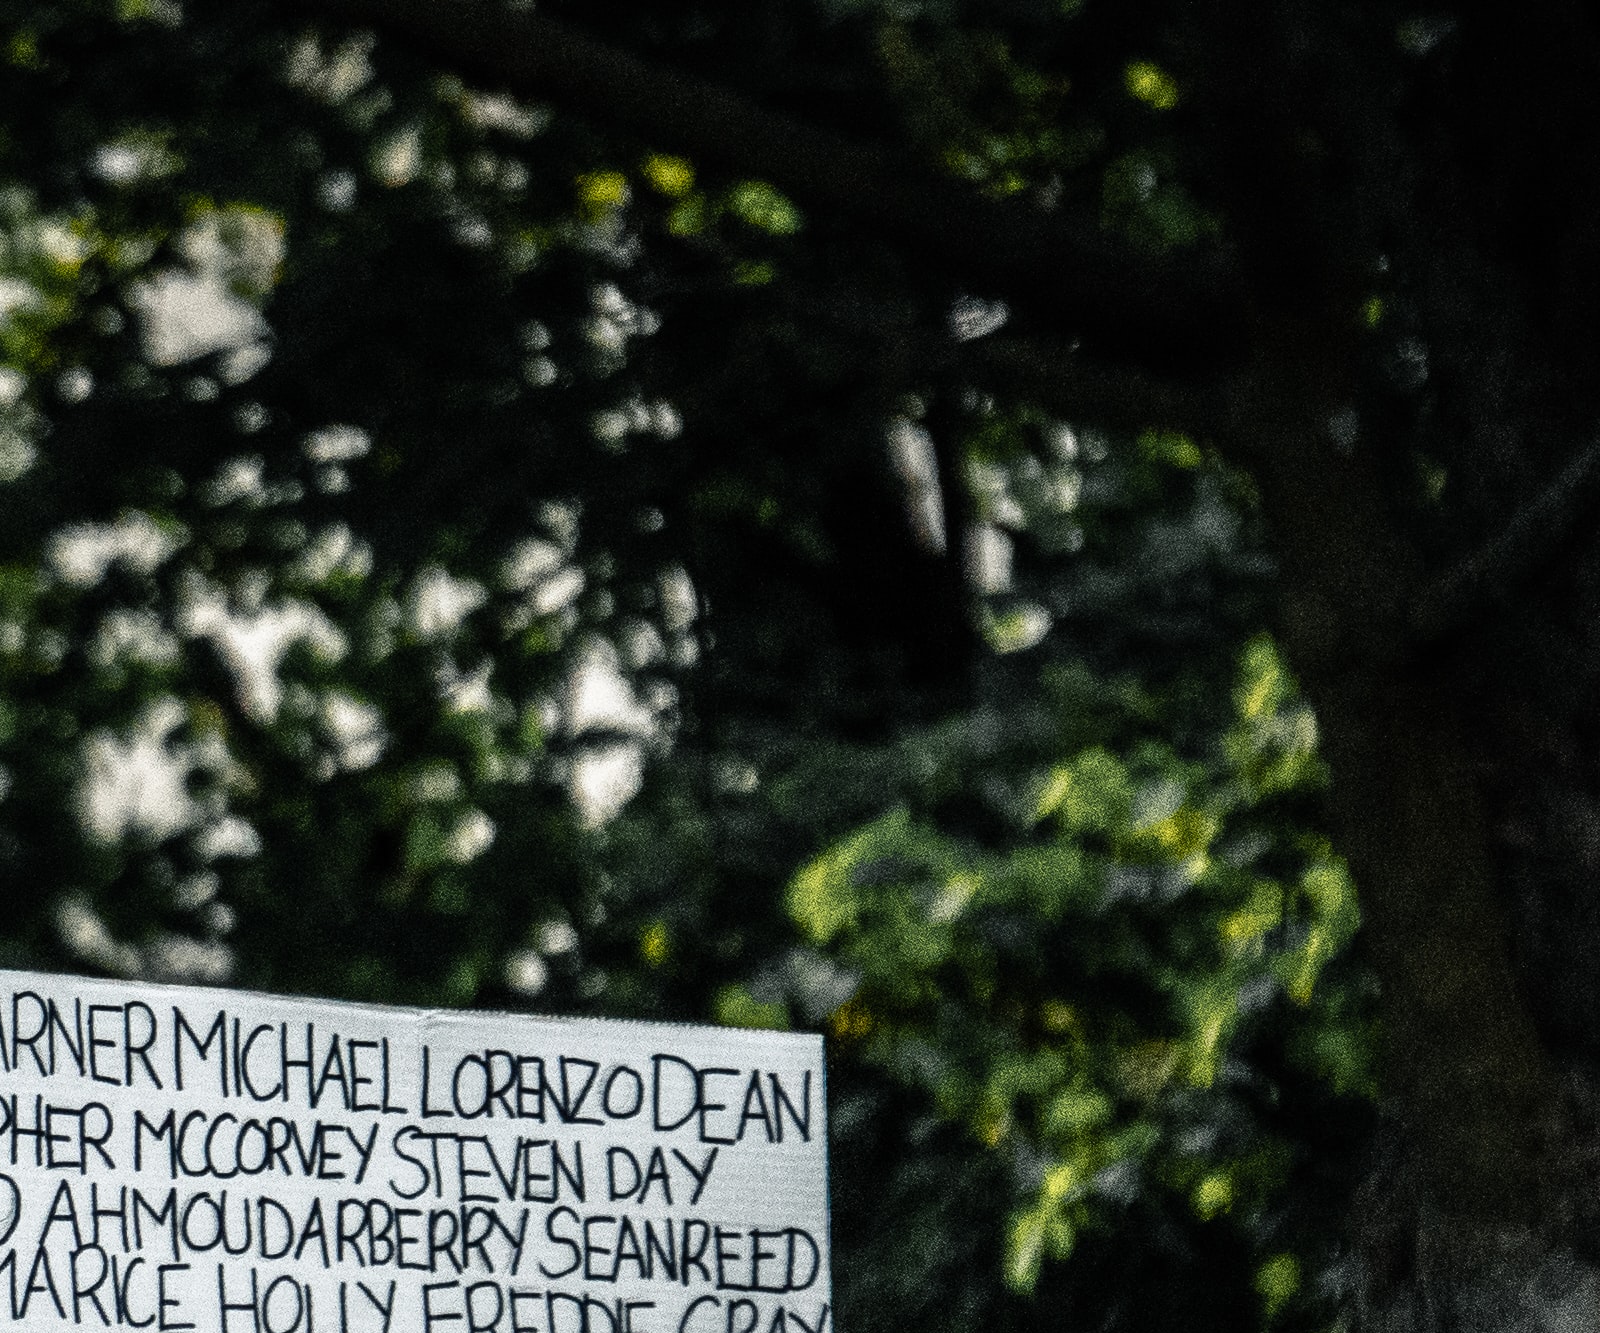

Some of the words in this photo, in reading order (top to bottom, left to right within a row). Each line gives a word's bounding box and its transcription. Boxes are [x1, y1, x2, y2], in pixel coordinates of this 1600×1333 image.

[173, 1004, 406, 1115] MICHAEL
[422, 1044, 644, 1126] LORENZO
[651, 1053, 812, 1145] DEAN
[134, 1108, 378, 1180] MCCORVEY
[390, 1124, 585, 1204] STEVEN
[608, 1145, 720, 1206] DAY
[40, 1179, 294, 1262] AHMOUD
[295, 1198, 530, 1276] ARBERRY
[539, 1206, 678, 1283] SEAN
[680, 1217, 821, 1294] REED
